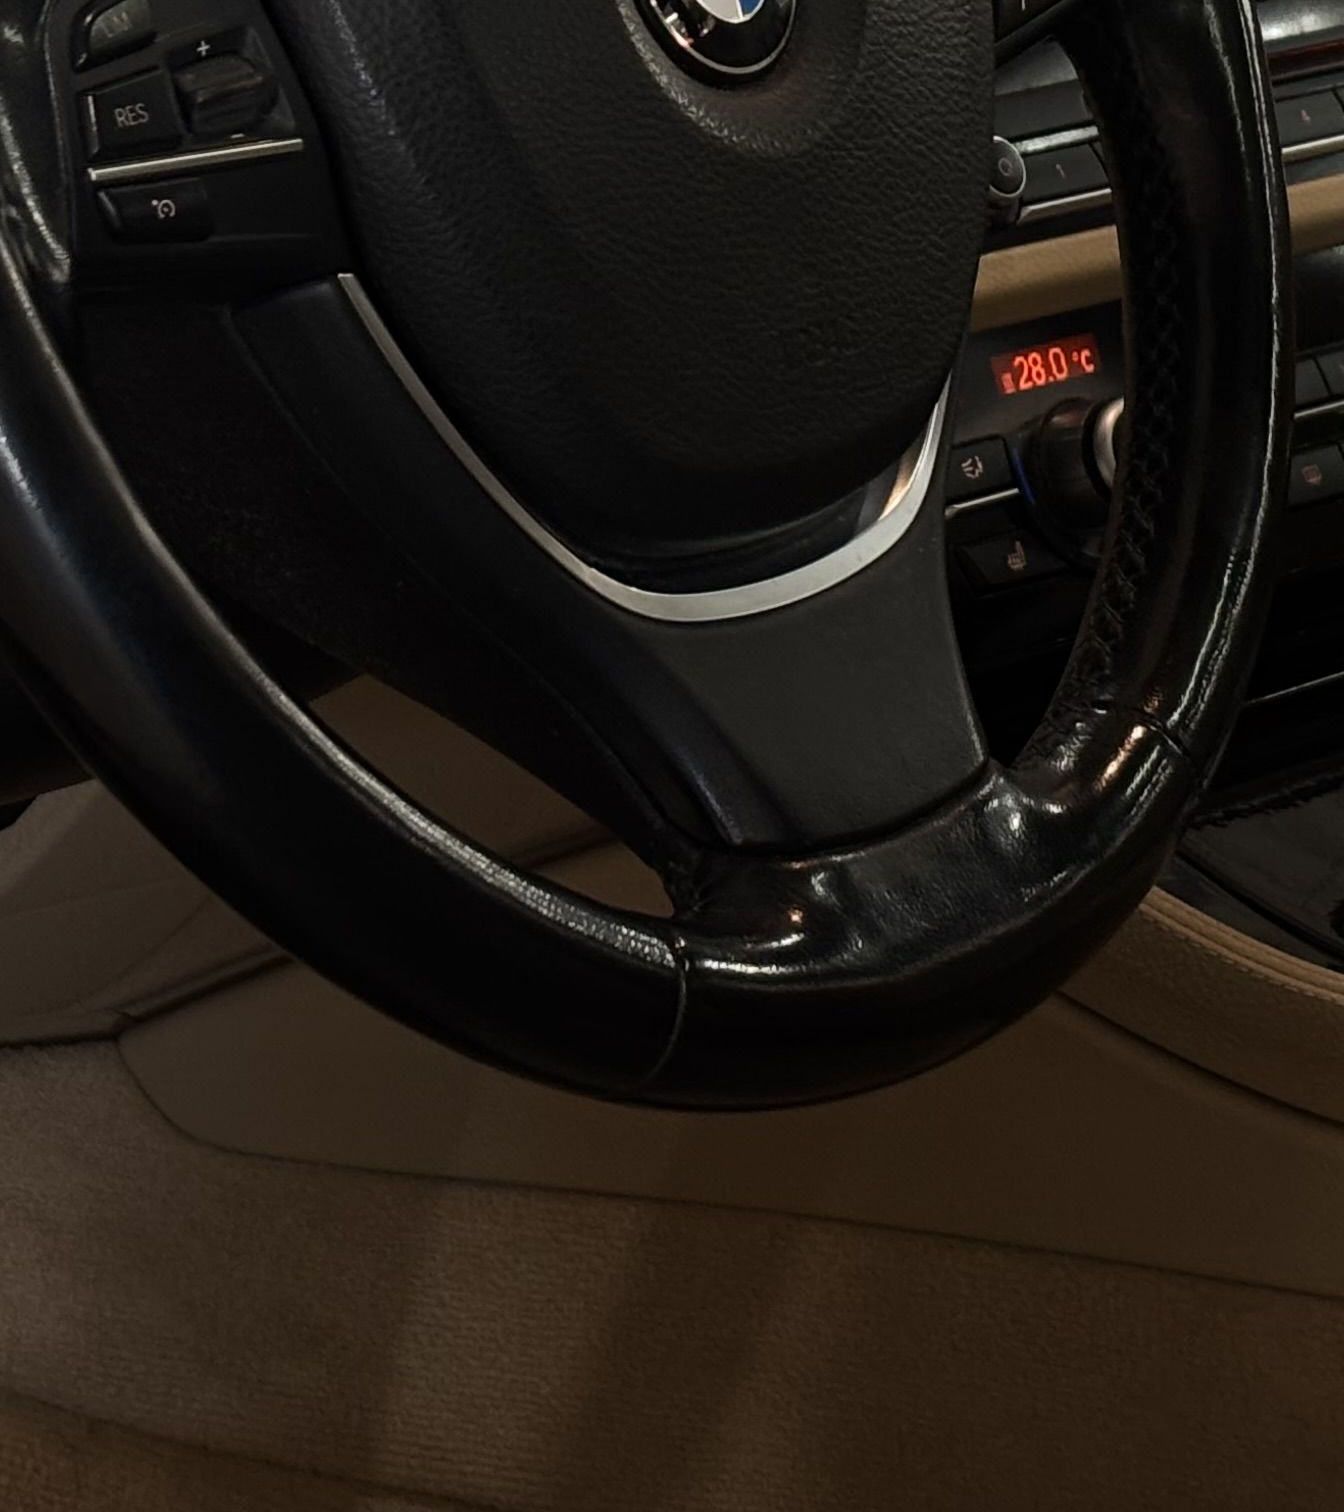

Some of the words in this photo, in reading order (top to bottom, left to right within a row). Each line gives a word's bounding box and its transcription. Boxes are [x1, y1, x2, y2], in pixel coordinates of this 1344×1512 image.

[113, 103, 150, 128] RES
[1013, 346, 1068, 391] 28.0
[1072, 348, 1095, 374] °C
